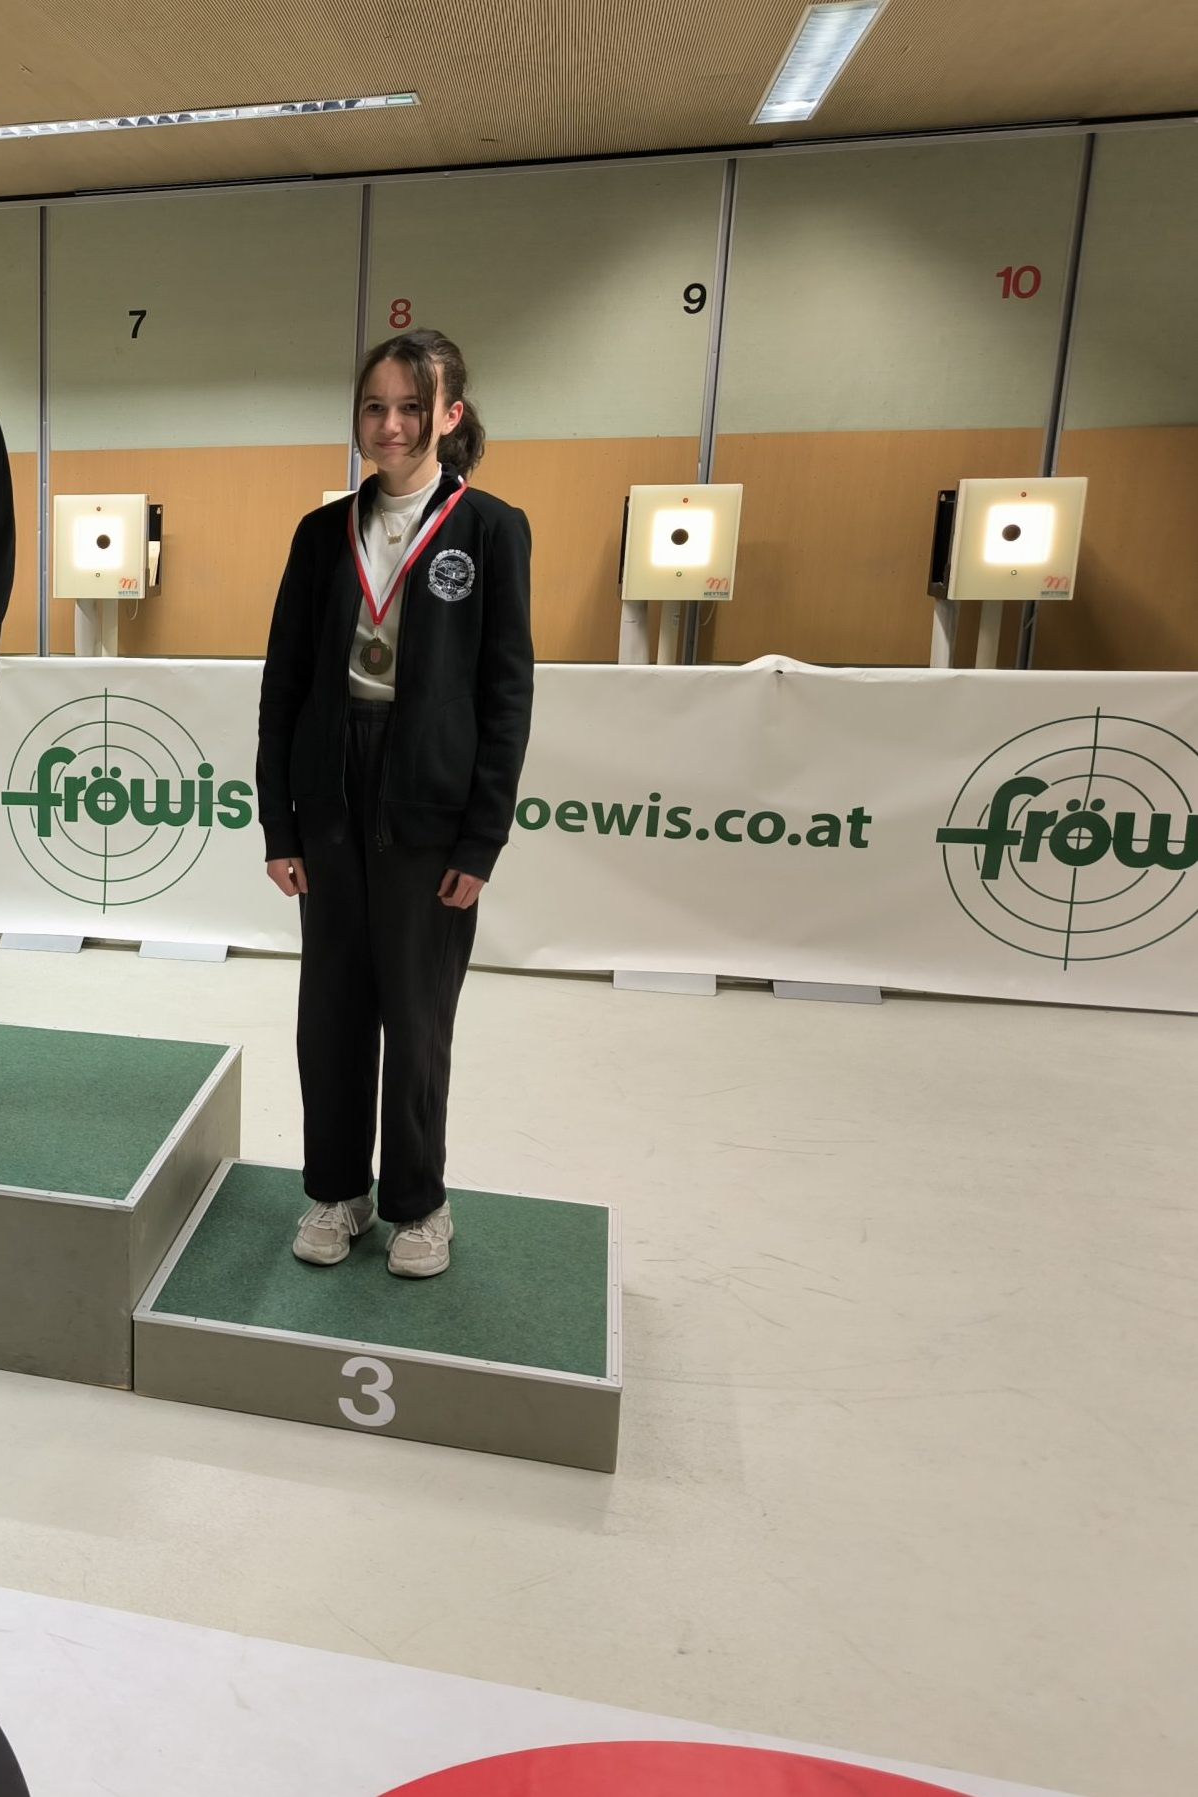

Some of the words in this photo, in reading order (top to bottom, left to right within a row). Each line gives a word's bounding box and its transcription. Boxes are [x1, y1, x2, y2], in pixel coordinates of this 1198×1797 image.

[683, 283, 707, 314] 9
[996, 265, 1041, 299] 10
[128, 310, 147, 338] 7
[389, 298, 411, 329] 8
[1, 746, 254, 838] fröwis
[515, 792, 872, 849] oewis.co.at
[935, 776, 1198, 880] fröw
[338, 1356, 396, 1427] 3
